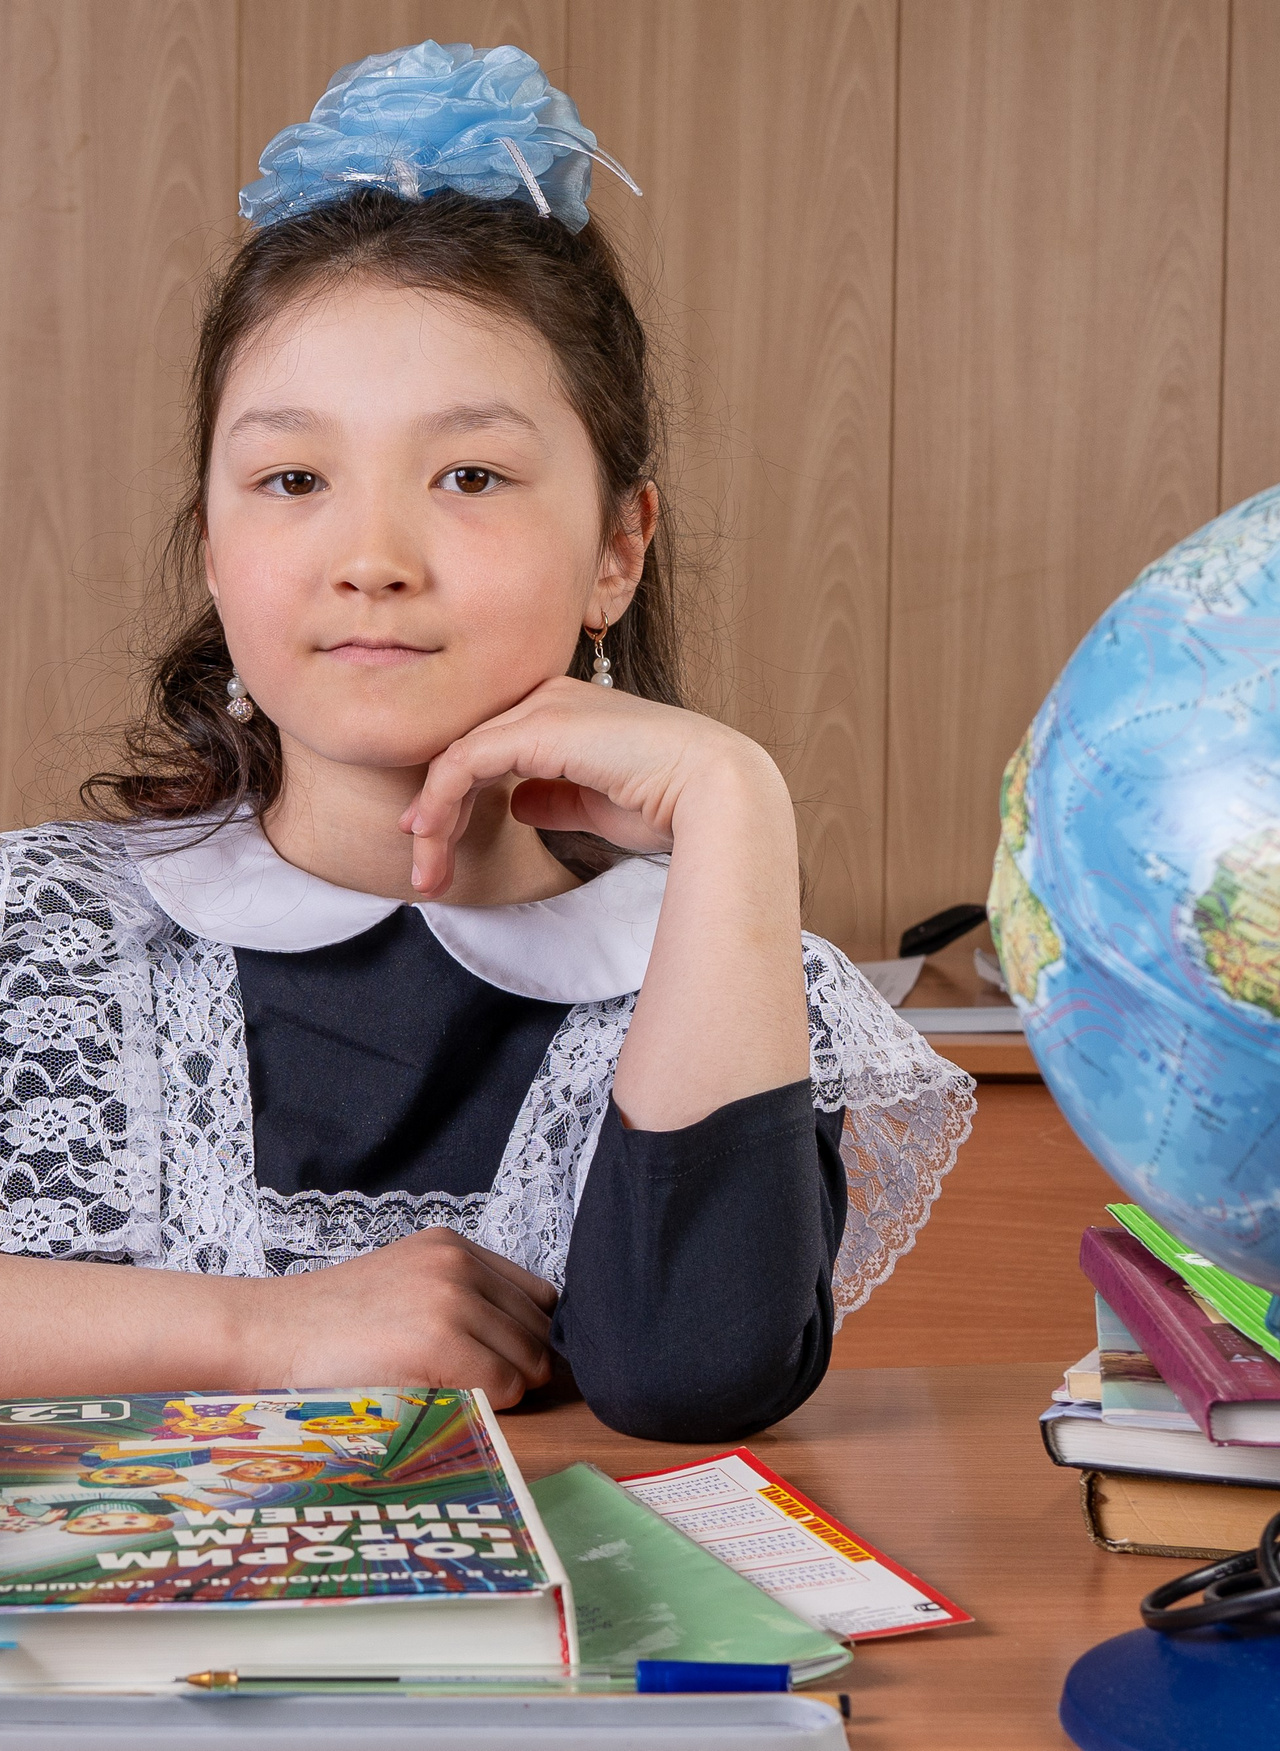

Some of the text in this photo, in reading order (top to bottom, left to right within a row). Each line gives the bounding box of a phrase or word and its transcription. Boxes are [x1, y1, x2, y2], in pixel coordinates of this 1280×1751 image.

[10, 1404, 111, 1422] 1-2
[183, 1503, 502, 1528] ПИШЕМ
[757, 1484, 811, 1520] ТАБЛИЦА
[799, 1516, 874, 1562] УМНОЖЕНИЯ
[172, 1522, 512, 1547] ЧИТАЕМ
[96, 1542, 519, 1570] ГОВОРИМ
[241, 1570, 448, 1586] ГОЛОВАНОВА,
[494, 1569, 529, 1578] М.
